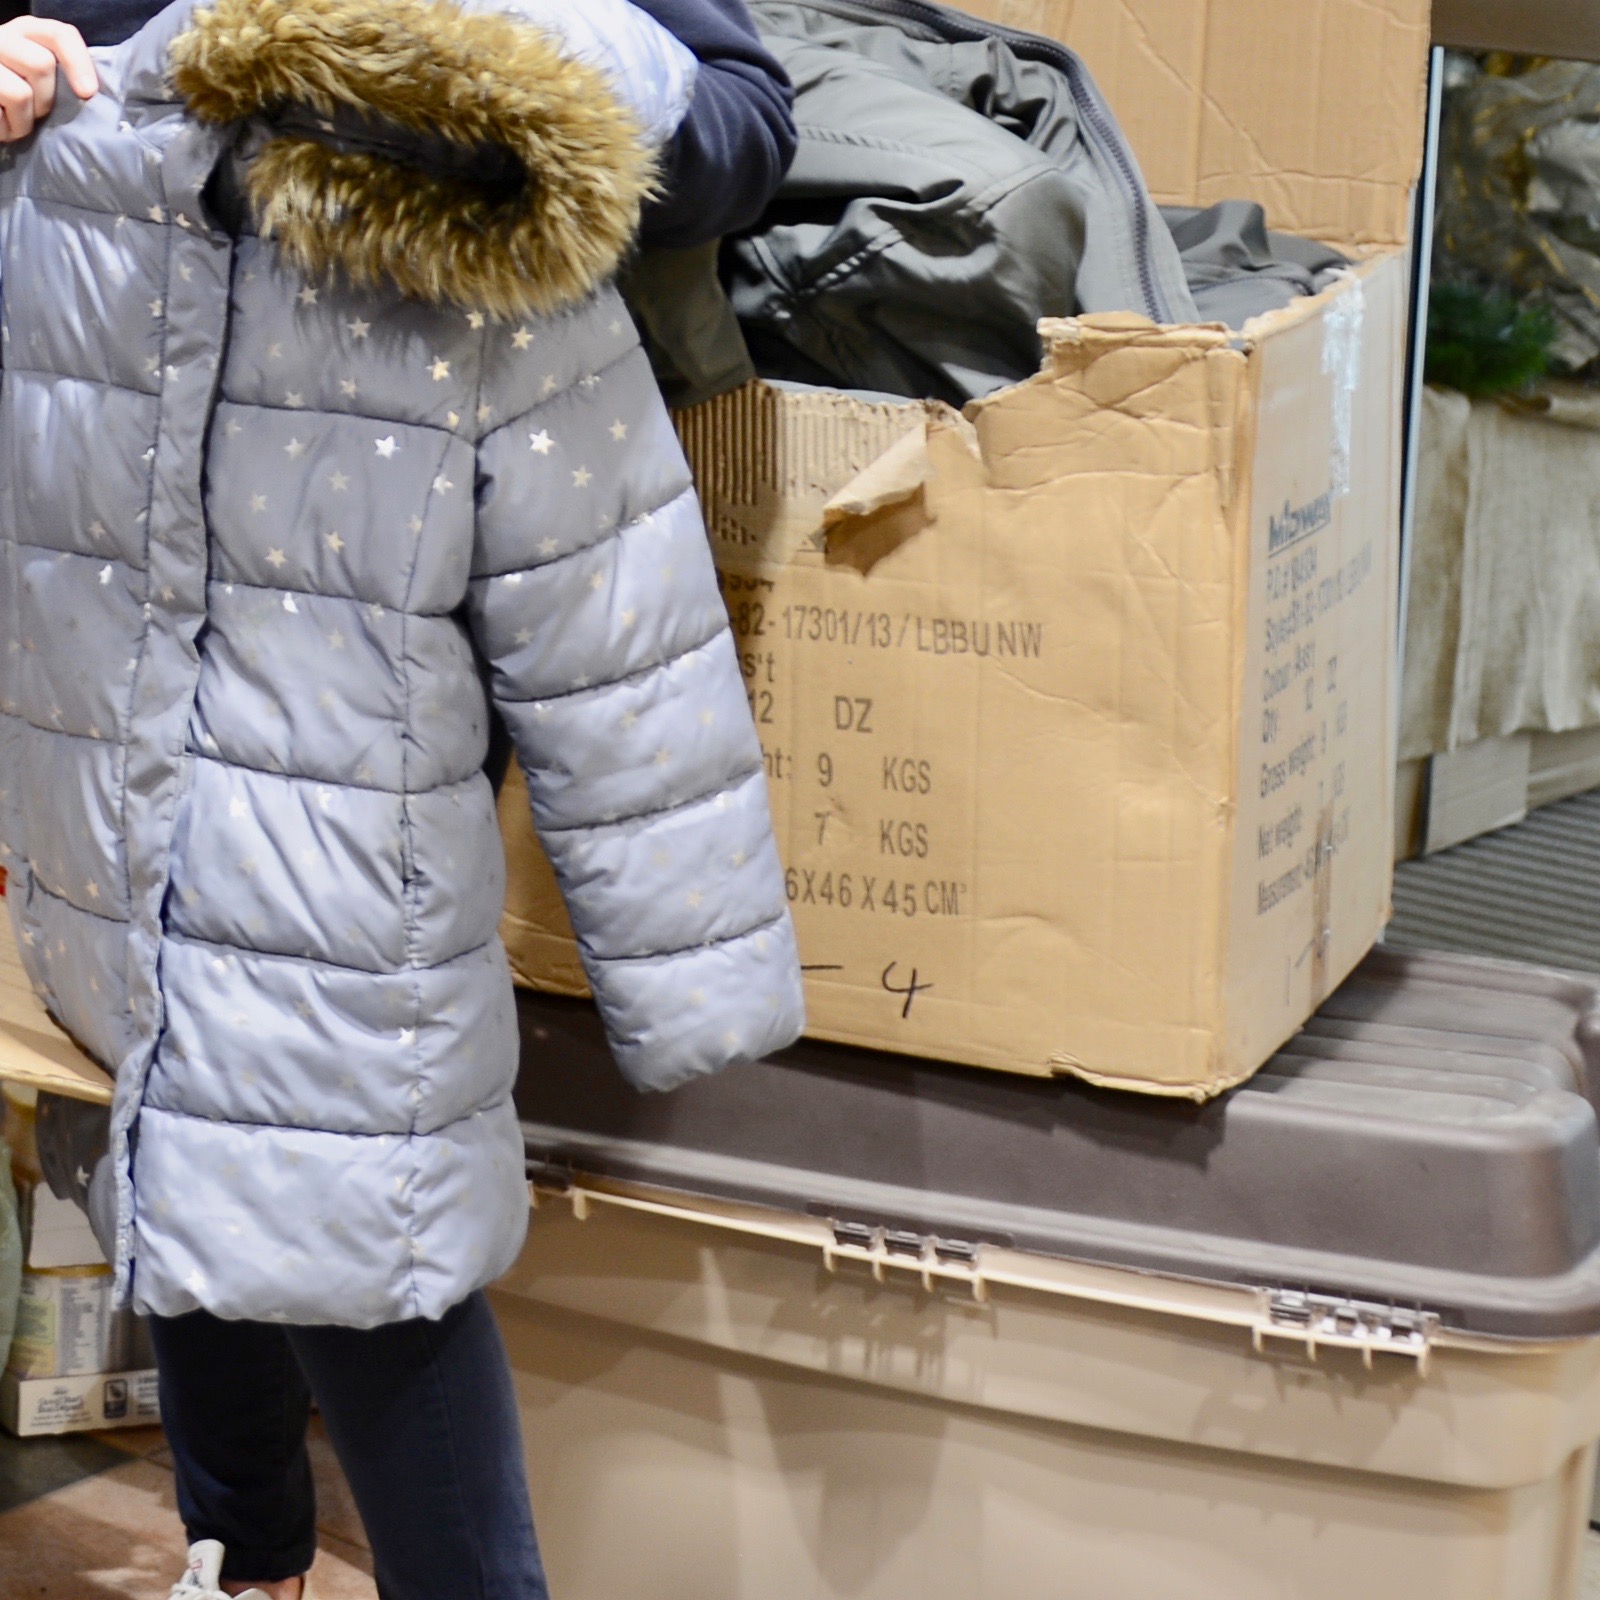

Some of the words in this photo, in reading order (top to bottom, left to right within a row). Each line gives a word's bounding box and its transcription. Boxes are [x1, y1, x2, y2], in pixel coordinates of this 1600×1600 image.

[834, 695, 874, 735] DZ
[817, 751, 834, 789] 9
[882, 755, 932, 795] KGS
[813, 811, 832, 847] 7
[879, 819, 930, 859] KGS
[880, 959, 934, 1020] 4
